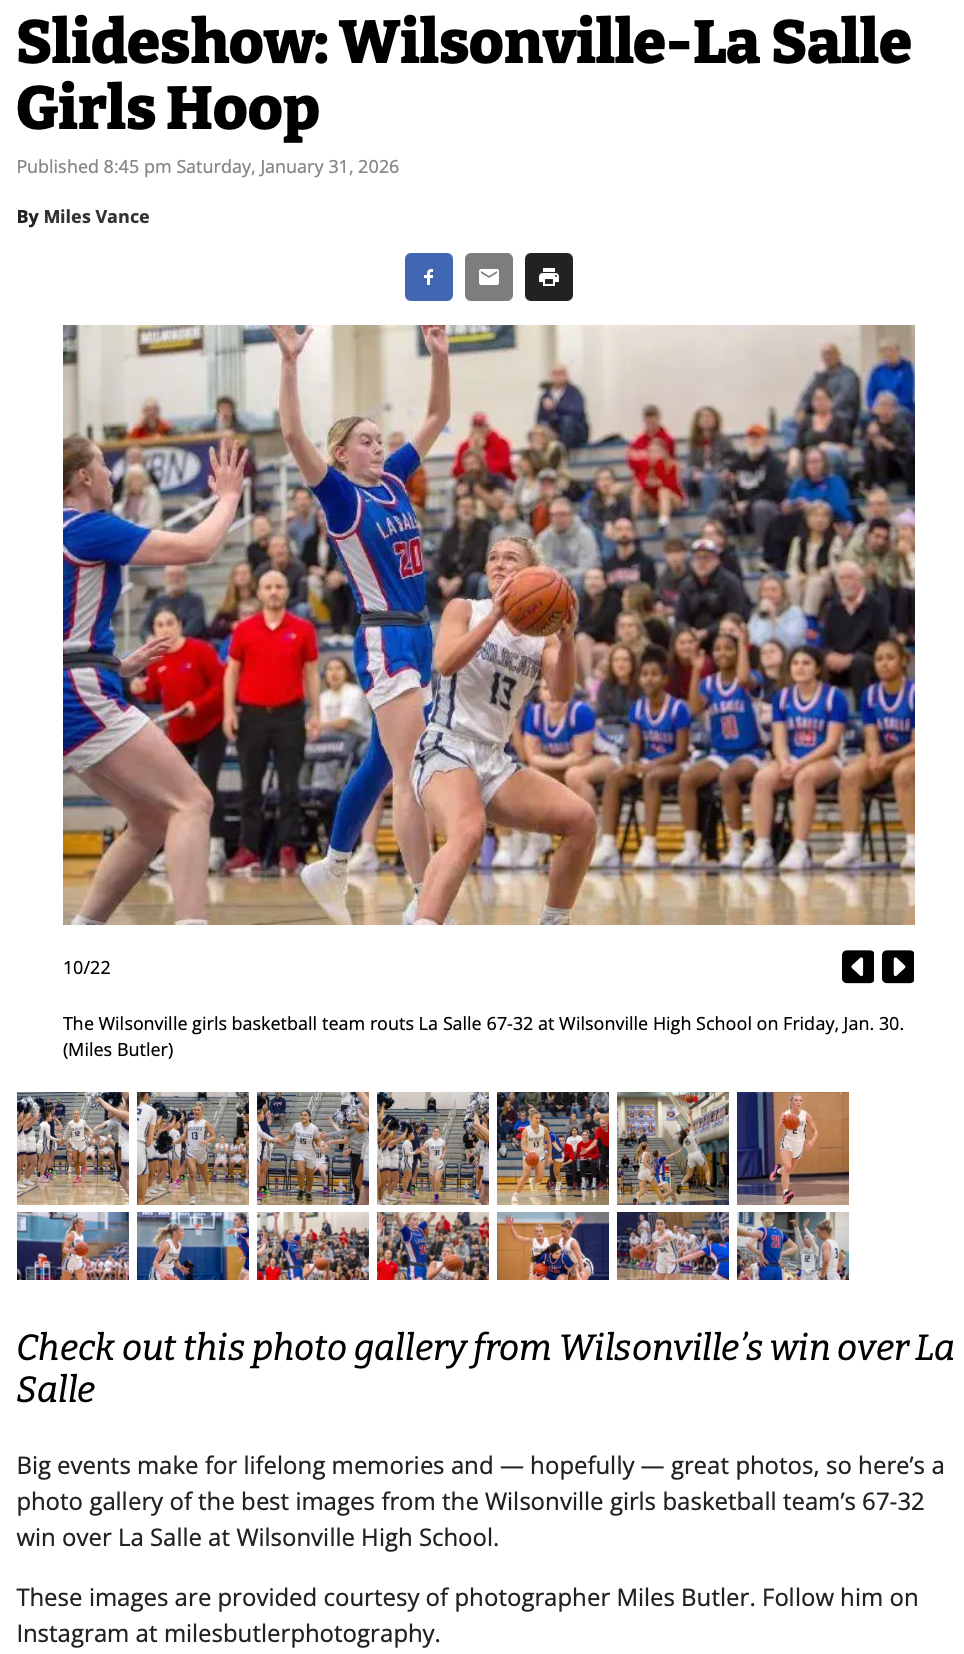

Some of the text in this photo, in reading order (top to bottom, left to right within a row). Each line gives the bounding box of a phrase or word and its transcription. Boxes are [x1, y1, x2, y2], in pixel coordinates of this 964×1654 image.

[18, 15, 911, 64] Slideshow: Wilsonville-La Salle
[17, 81, 319, 143] Girls Hoop
[18, 159, 399, 178] Published 8:45 pm Saturday, January 31, 2026
[18, 209, 149, 228] By Miles Vance
[393, 536, 424, 580] 20
[490, 672, 517, 711] 13
[64, 961, 110, 974] 10/22
[63, 1016, 903, 1035] The Wilsonville girls basketball team routs La Salle 67-32 at Wilsonville High School on Friday, Jan. 30.
[63, 1042, 173, 1059] (Miles Butler)
[191, 1132, 198, 1140] 13
[771, 1235, 780, 1248] 20
[835, 1248, 838, 1259] 3
[18, 1331, 953, 1369] Check out this photo gallery from Wilsonville’s win over La
[17, 1373, 95, 1403] Salle
[18, 1456, 51, 1480] Big
[58, 1458, 130, 1475] events
[139, 1455, 198, 1475] make
[205, 1455, 237, 1475] for
[245, 1455, 326, 1480] lifelong
[333, 1456, 444, 1475] memories
[452, 1455, 492, 1475] and
[532, 1455, 635, 1480] hopefully
[671, 1458, 729, 1480] great
[737, 1455, 818, 1480] photos,
[827, 1460, 851, 1475] so
[860, 1455, 924, 1475] here’s
[932, 1460, 943, 1475] a
[18, 1491, 924, 1516] photo gallery of the best images from the Wilsonville girls basketball team’s 67-32
[16, 1527, 498, 1552] win over La Salle at Wilsonville High School.
[16, 1587, 917, 1612] These images are provided courtesy of photographer Miles Butler. Follow him on
[18, 1623, 439, 1648] Instagram at milesbutlerphotography.
